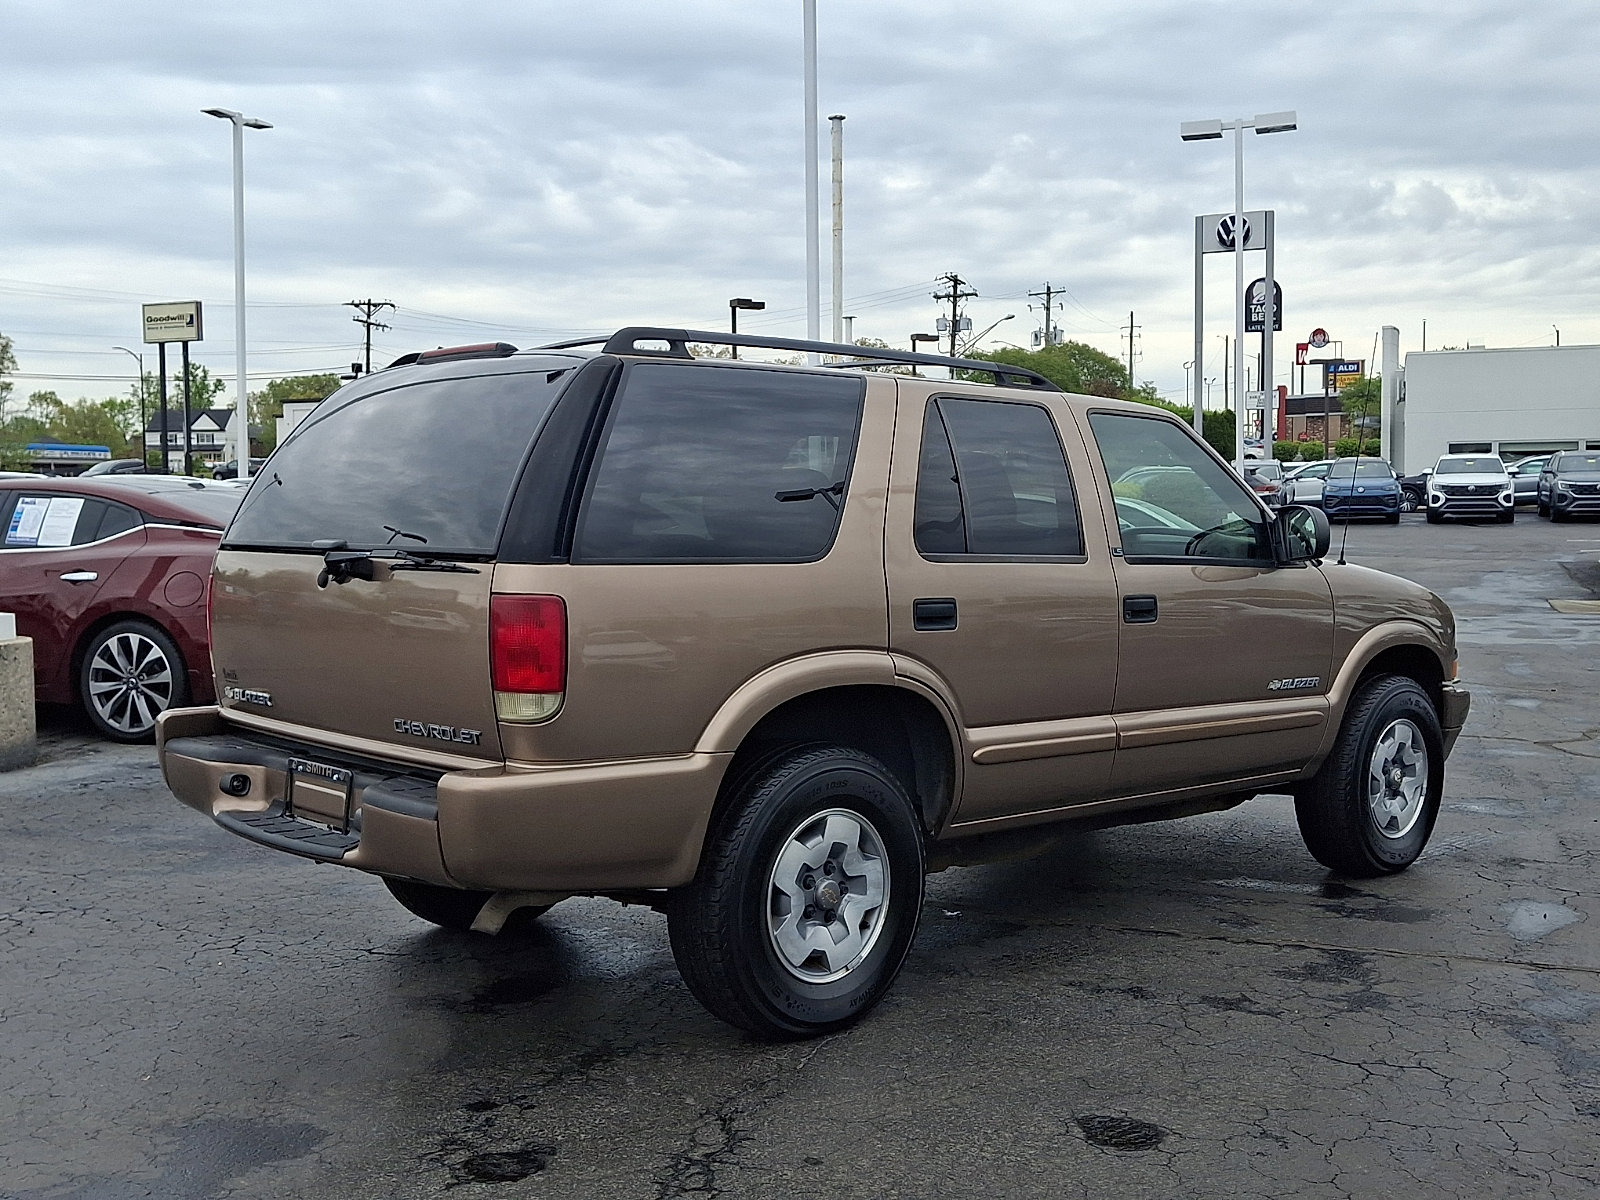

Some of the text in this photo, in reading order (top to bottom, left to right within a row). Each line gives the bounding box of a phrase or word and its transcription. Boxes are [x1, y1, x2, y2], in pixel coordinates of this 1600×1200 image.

[146, 313, 185, 323] Goodwill
[1338, 364, 1358, 372] ALDI
[1280, 676, 1320, 690] BLAZER
[233, 687, 273, 707] BLAZER
[393, 718, 483, 746] CHEVROLET
[305, 761, 333, 778] SMITH
